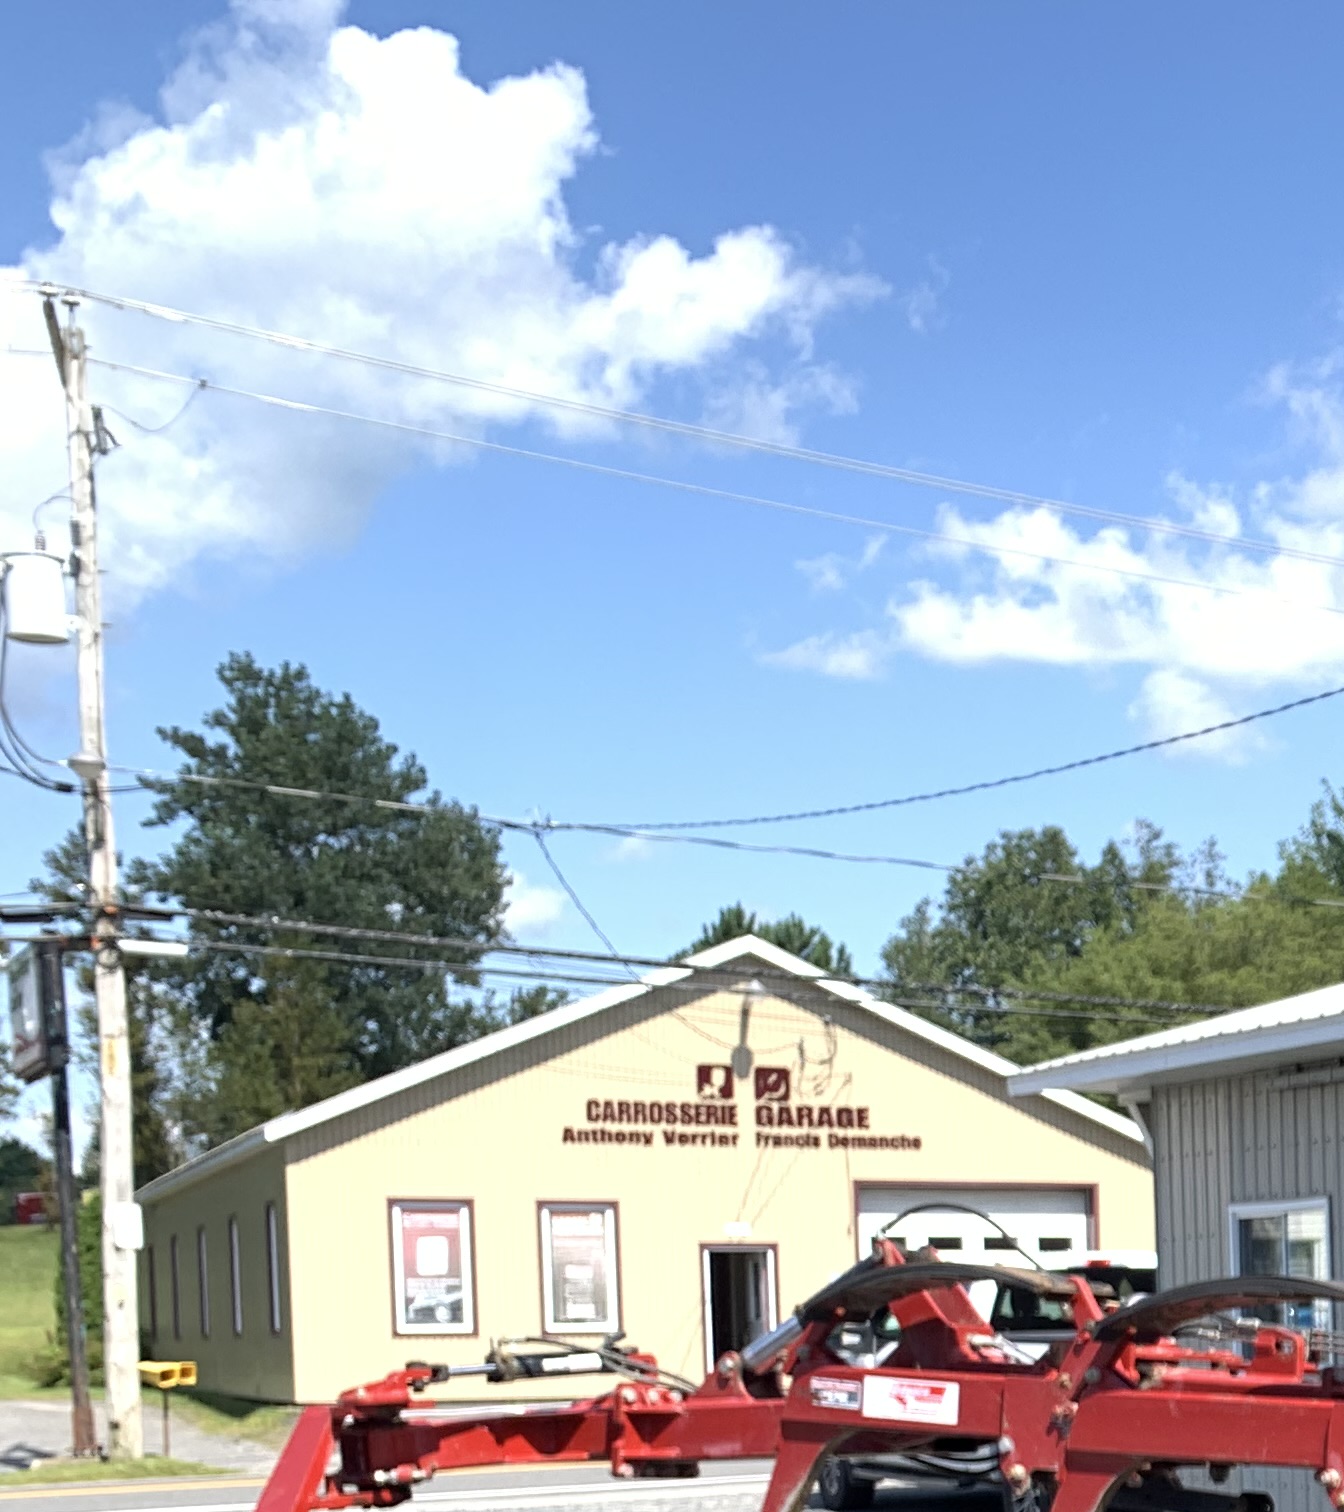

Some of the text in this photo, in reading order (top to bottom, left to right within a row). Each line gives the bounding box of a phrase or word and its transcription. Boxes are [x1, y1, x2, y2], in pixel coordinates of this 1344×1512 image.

[586, 1098, 738, 1126] CARROSSERIE
[755, 1104, 870, 1129] GARAGE
[562, 1127, 739, 1147] Anthony Verrier
[755, 1132, 922, 1150] Francis Demanche
